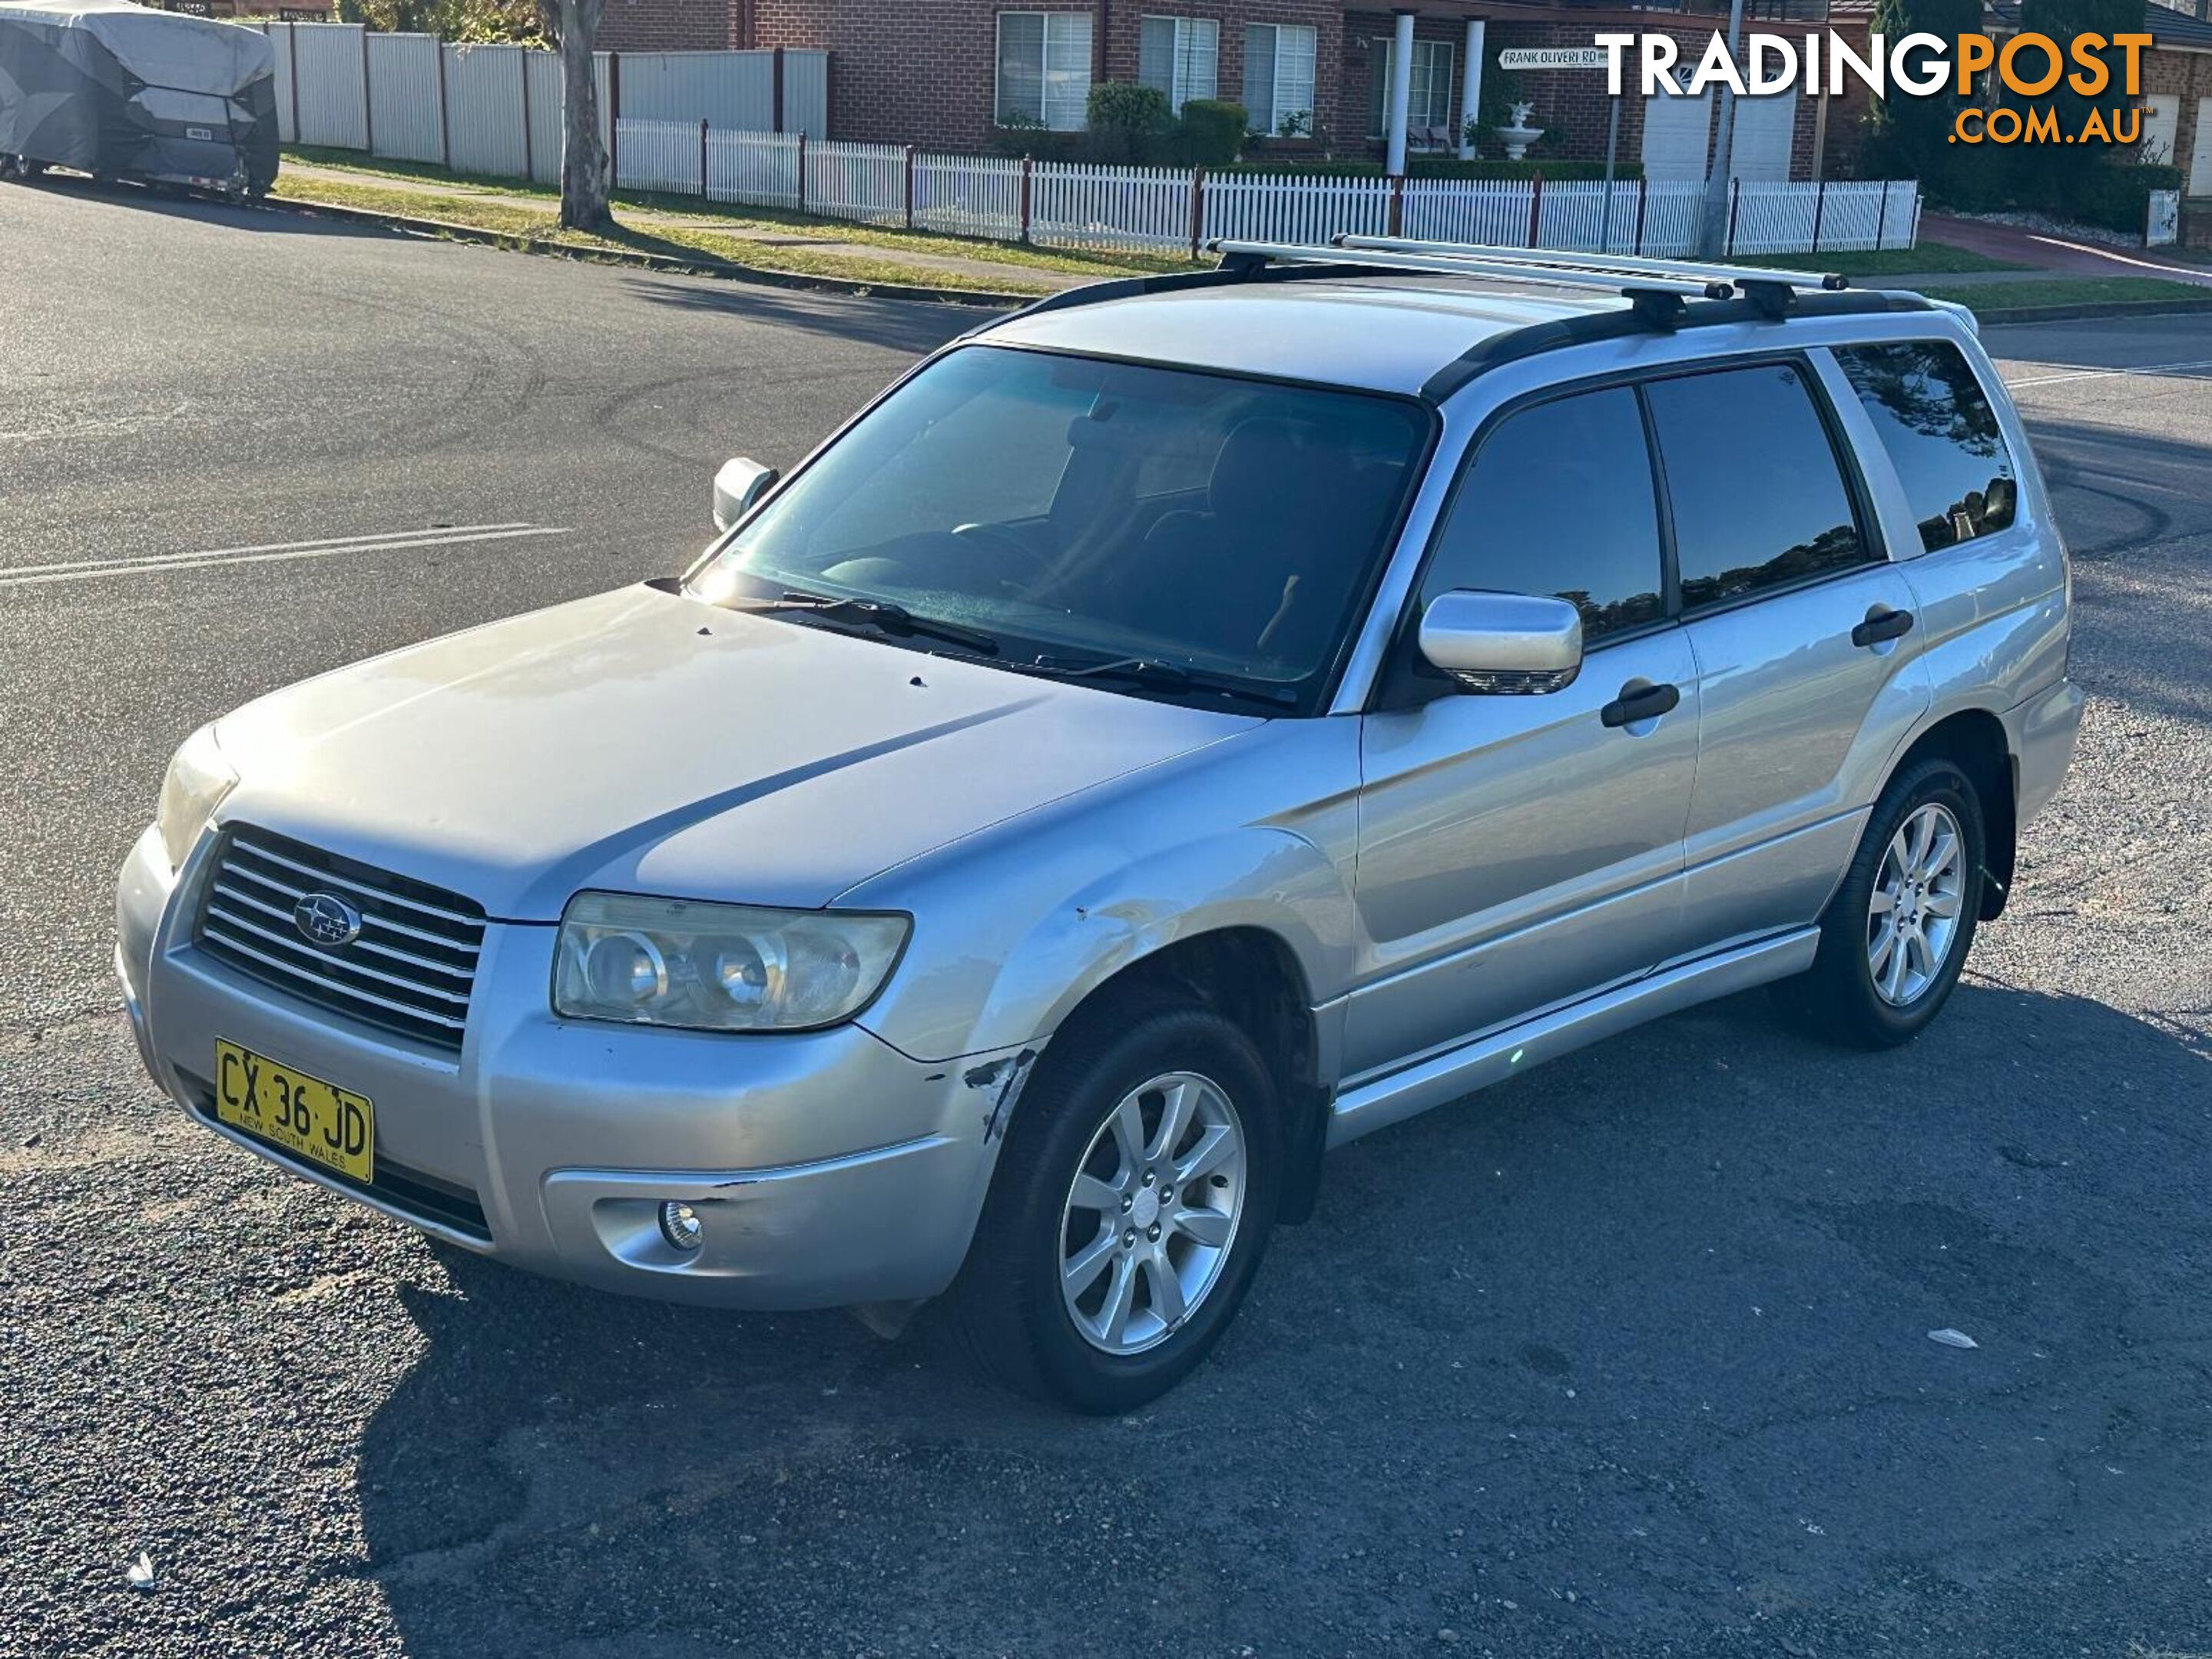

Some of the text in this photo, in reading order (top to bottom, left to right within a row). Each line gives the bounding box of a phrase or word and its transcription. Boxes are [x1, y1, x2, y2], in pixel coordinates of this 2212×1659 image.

[1504, 51, 1596, 64] FRANK OLIVERI RD
[240, 1112, 346, 1169] NEW SOUTH WALES
